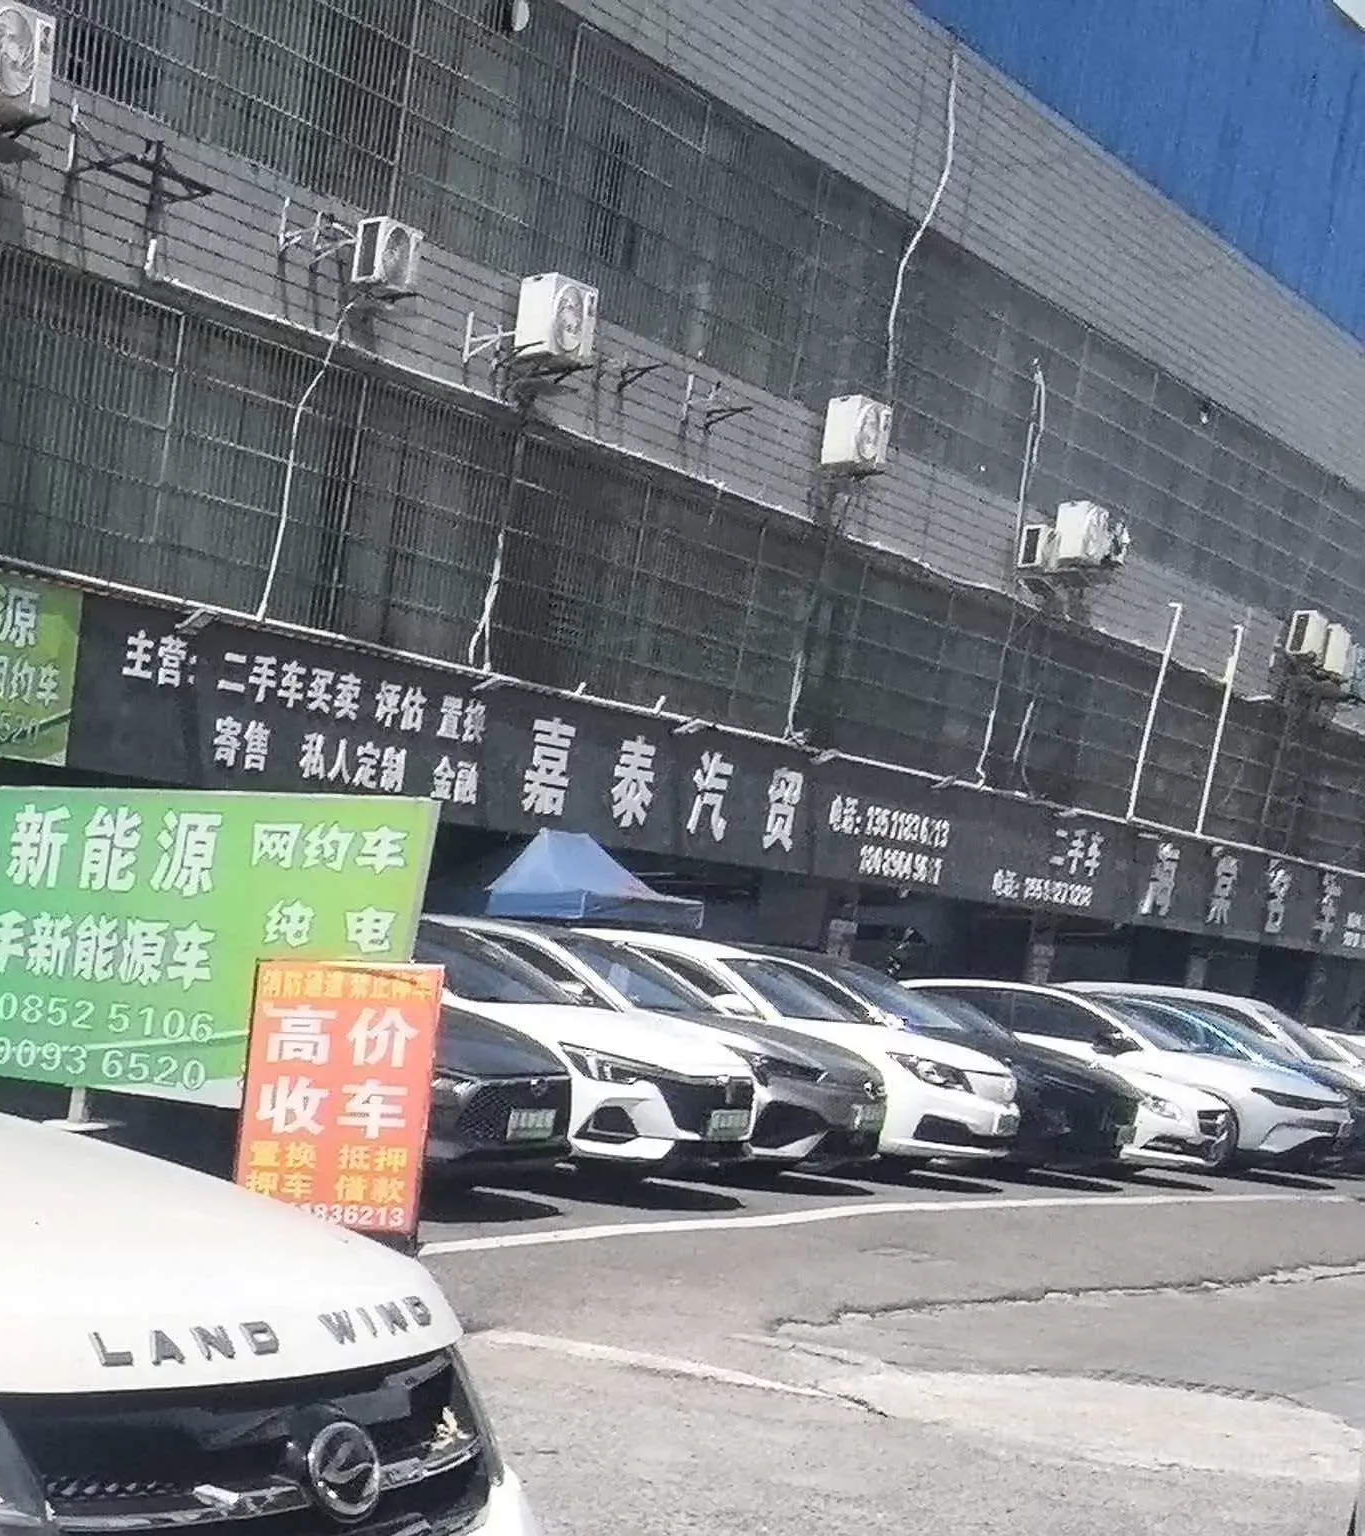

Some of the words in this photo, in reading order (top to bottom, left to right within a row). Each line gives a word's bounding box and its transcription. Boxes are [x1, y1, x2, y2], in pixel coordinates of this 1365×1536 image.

[217, 652, 362, 720] 二手车买卖
[375, 681, 427, 733] 评估
[435, 695, 487, 744] 置换
[213, 716, 270, 772] 寄售
[300, 732, 406, 793] 私人定制
[431, 756, 478, 804] 金融
[522, 717, 803, 852] 嘉泰汽贸
[252, 822, 407, 875] 网约车
[263, 899, 397, 954] 纯电
[108, 1004, 215, 1043] 5106
[264, 1003, 420, 1068] 高价
[101, 1050, 207, 1090] 6520
[255, 1075, 409, 1140] 收车
[249, 1140, 316, 1170] 置换
[339, 1144, 408, 1173] 抵押
[244, 1171, 314, 1199] 押车
[334, 1175, 406, 1205] 借款
[297, 1202, 406, 1228] 836213
[87, 1320, 280, 1367] LAND
[317, 1295, 432, 1345] WIND
